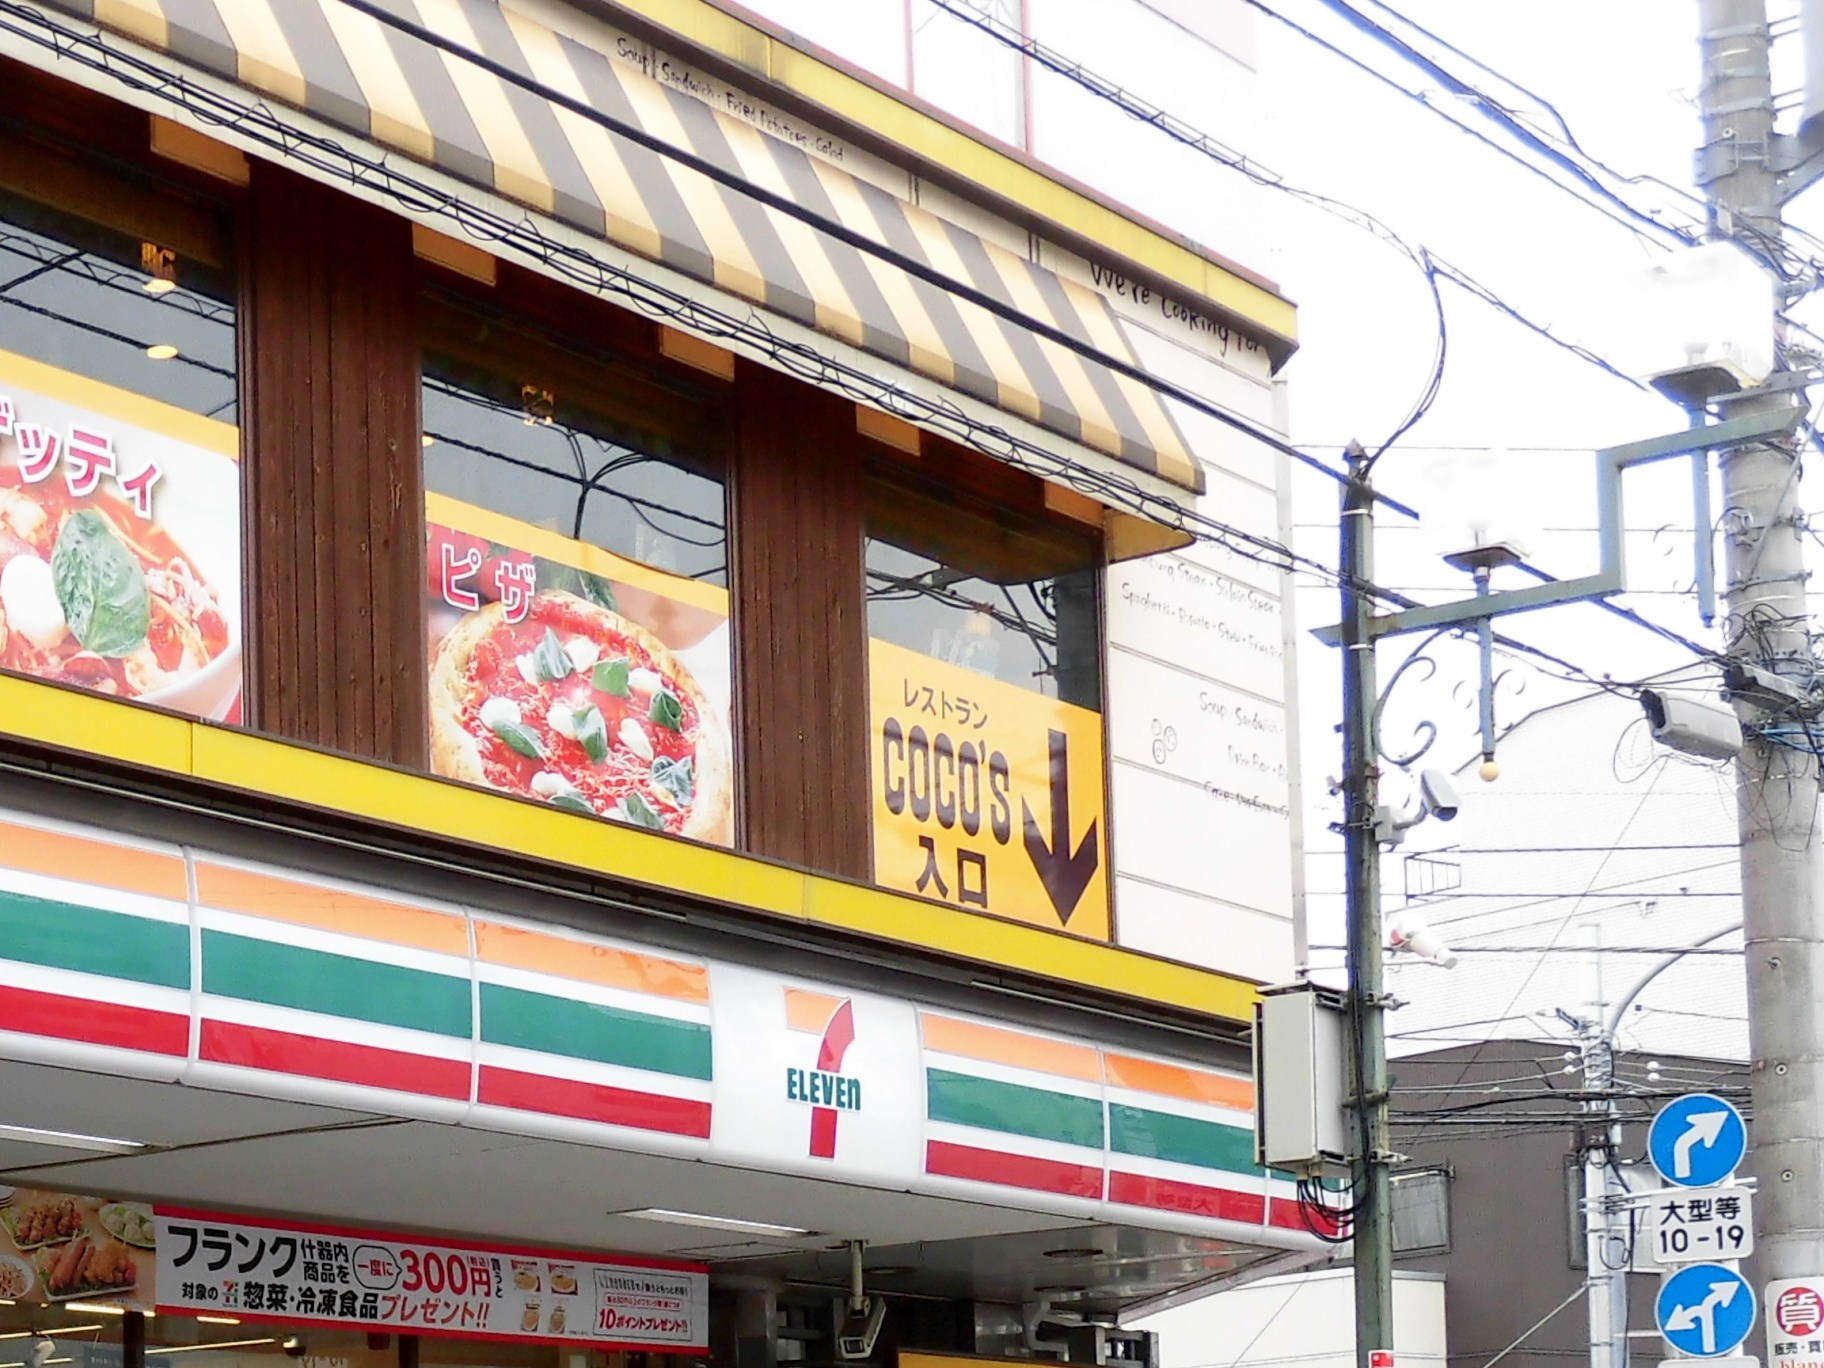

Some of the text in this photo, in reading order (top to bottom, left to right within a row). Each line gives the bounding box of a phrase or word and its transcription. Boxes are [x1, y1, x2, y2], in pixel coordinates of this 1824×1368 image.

[440, 544, 536, 624] ピザ
[903, 678, 988, 729] レストラン
[882, 717, 1011, 845] COCO'S
[915, 836, 988, 909] 入口
[1660, 1196, 1742, 1225] 大型等
[167, 1225, 298, 1278] フランク
[357, 1256, 393, 1277] 一度に
[1659, 1225, 1745, 1254] 10-19
[182, 1282, 219, 1301] 対象の
[1780, 1293, 1822, 1331] 質
[1775, 1342, 1824, 1355] 販売・買
